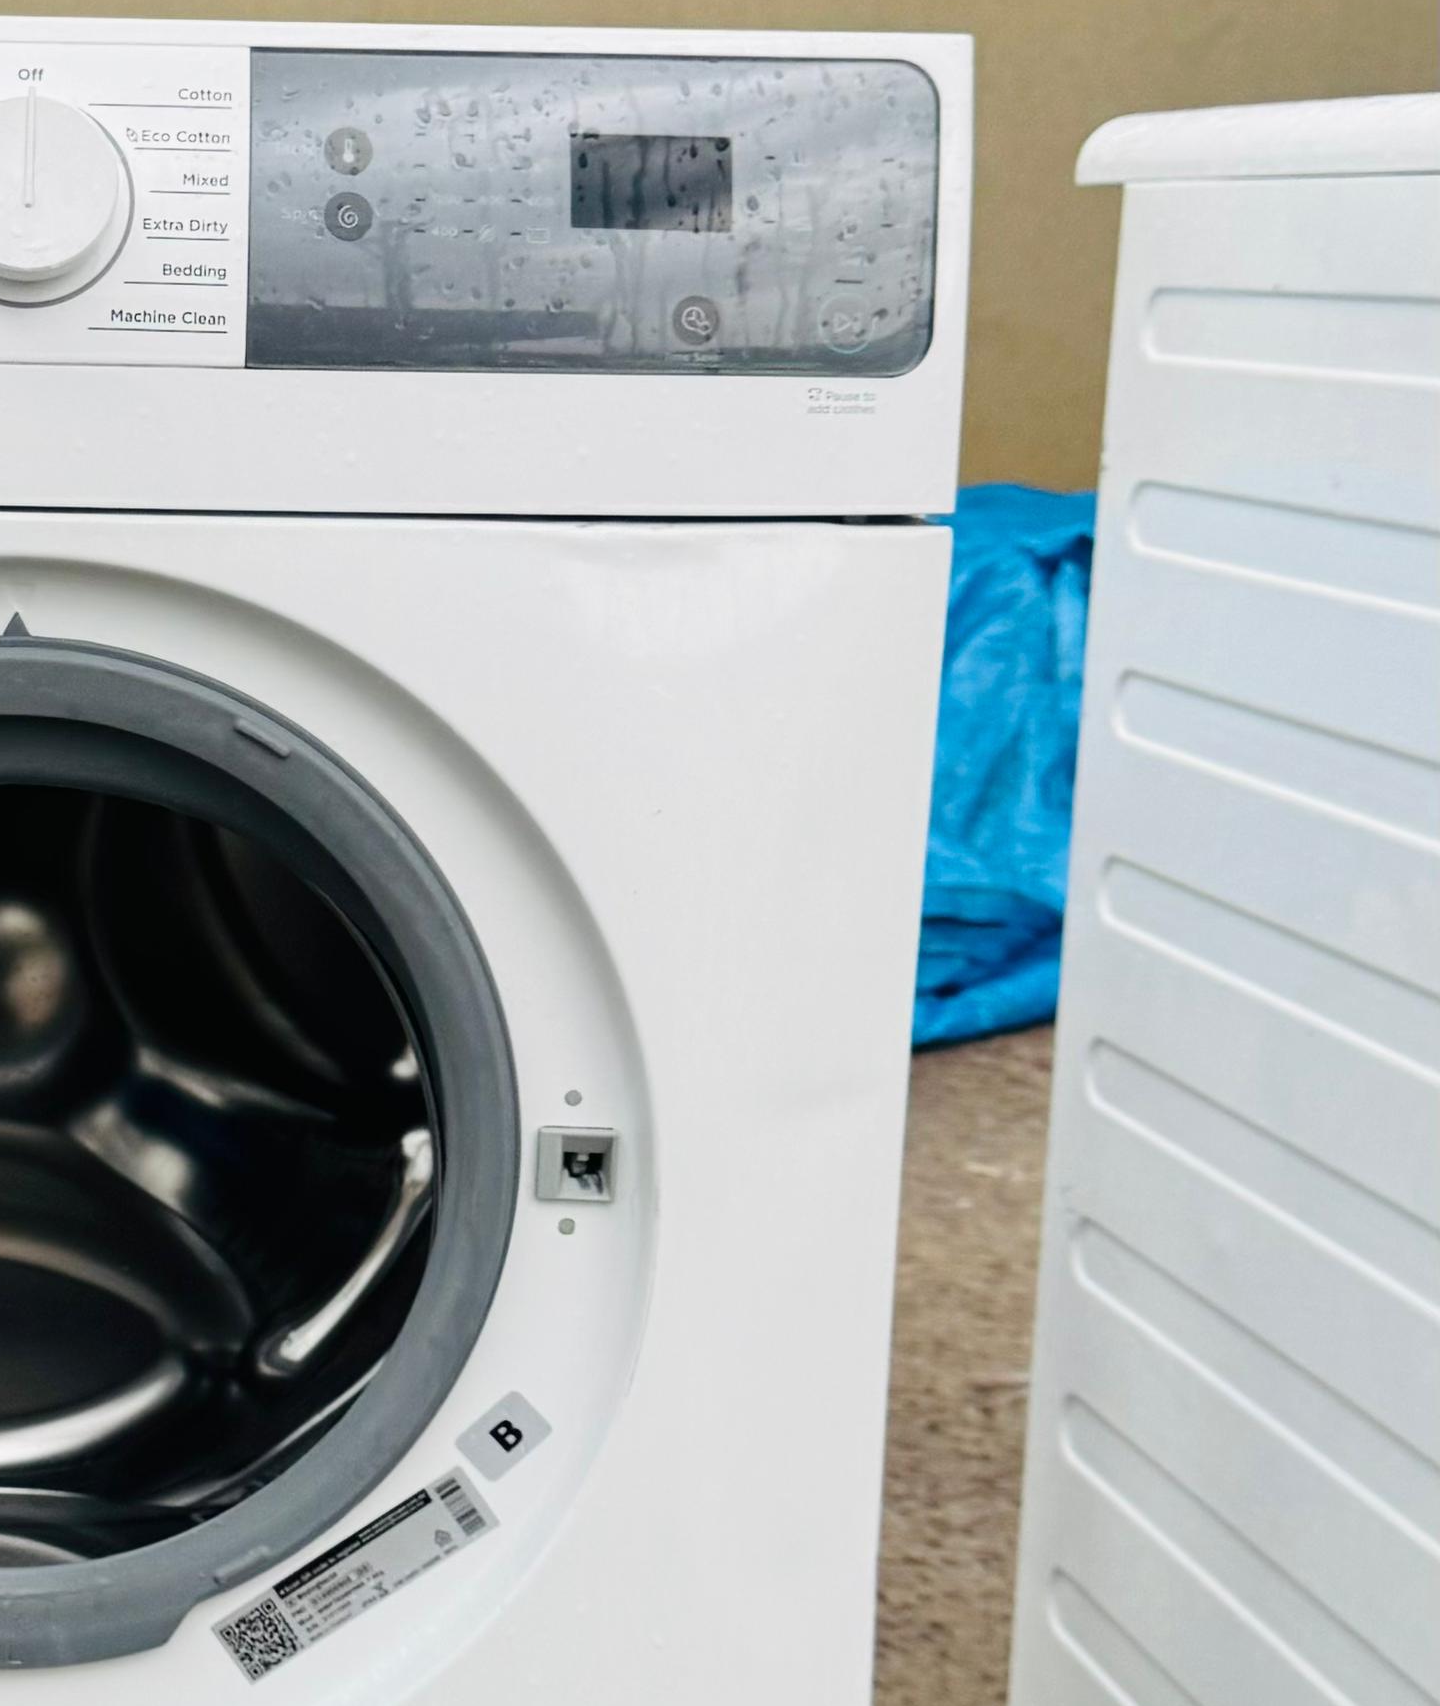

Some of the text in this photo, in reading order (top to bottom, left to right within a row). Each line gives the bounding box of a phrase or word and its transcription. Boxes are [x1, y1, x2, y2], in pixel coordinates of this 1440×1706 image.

[18, 68, 44, 82] Off
[178, 87, 232, 102] Cotton
[141, 129, 231, 144] Eco Cotton
[183, 173, 229, 187] Mixed
[142, 217, 228, 235] Extra Dirty
[162, 263, 227, 281] Bedding
[110, 309, 226, 326] Machine Clean
[489, 1420, 523, 1453] B
